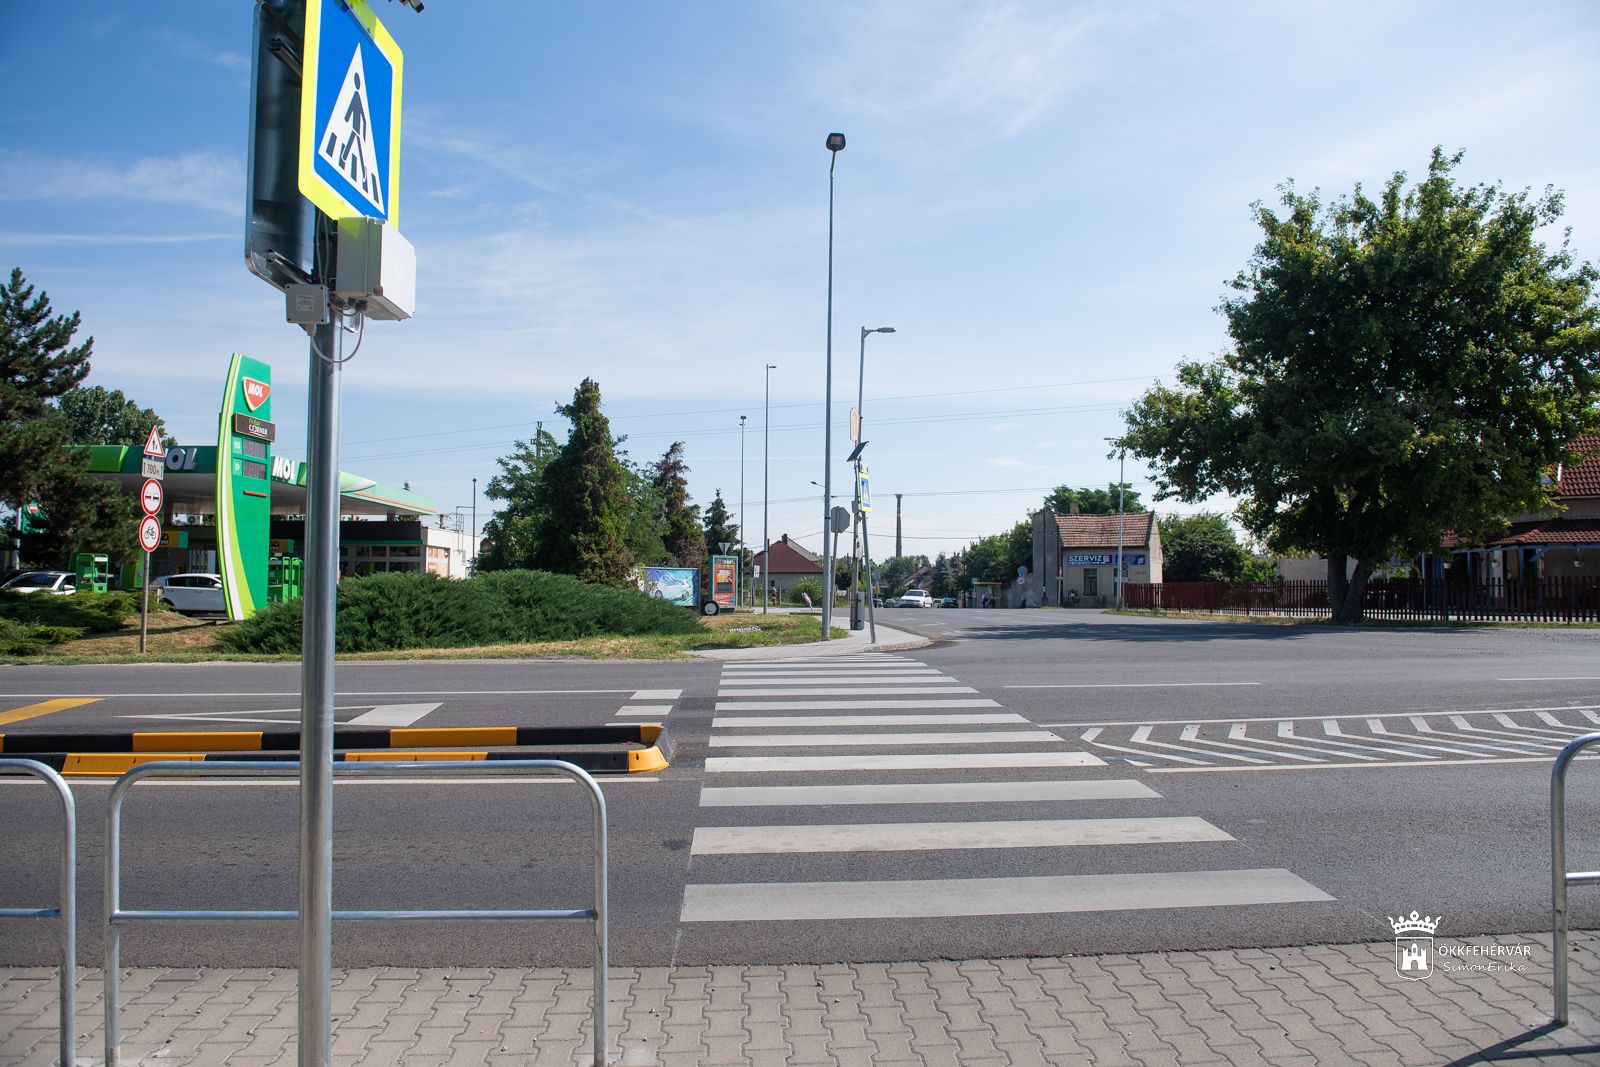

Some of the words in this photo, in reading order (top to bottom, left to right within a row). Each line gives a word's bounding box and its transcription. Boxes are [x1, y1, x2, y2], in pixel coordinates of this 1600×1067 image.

[248, 382, 263, 397] MOL
[248, 424, 268, 435] CORNER
[164, 447, 199, 471] OL
[272, 456, 295, 480] MOL
